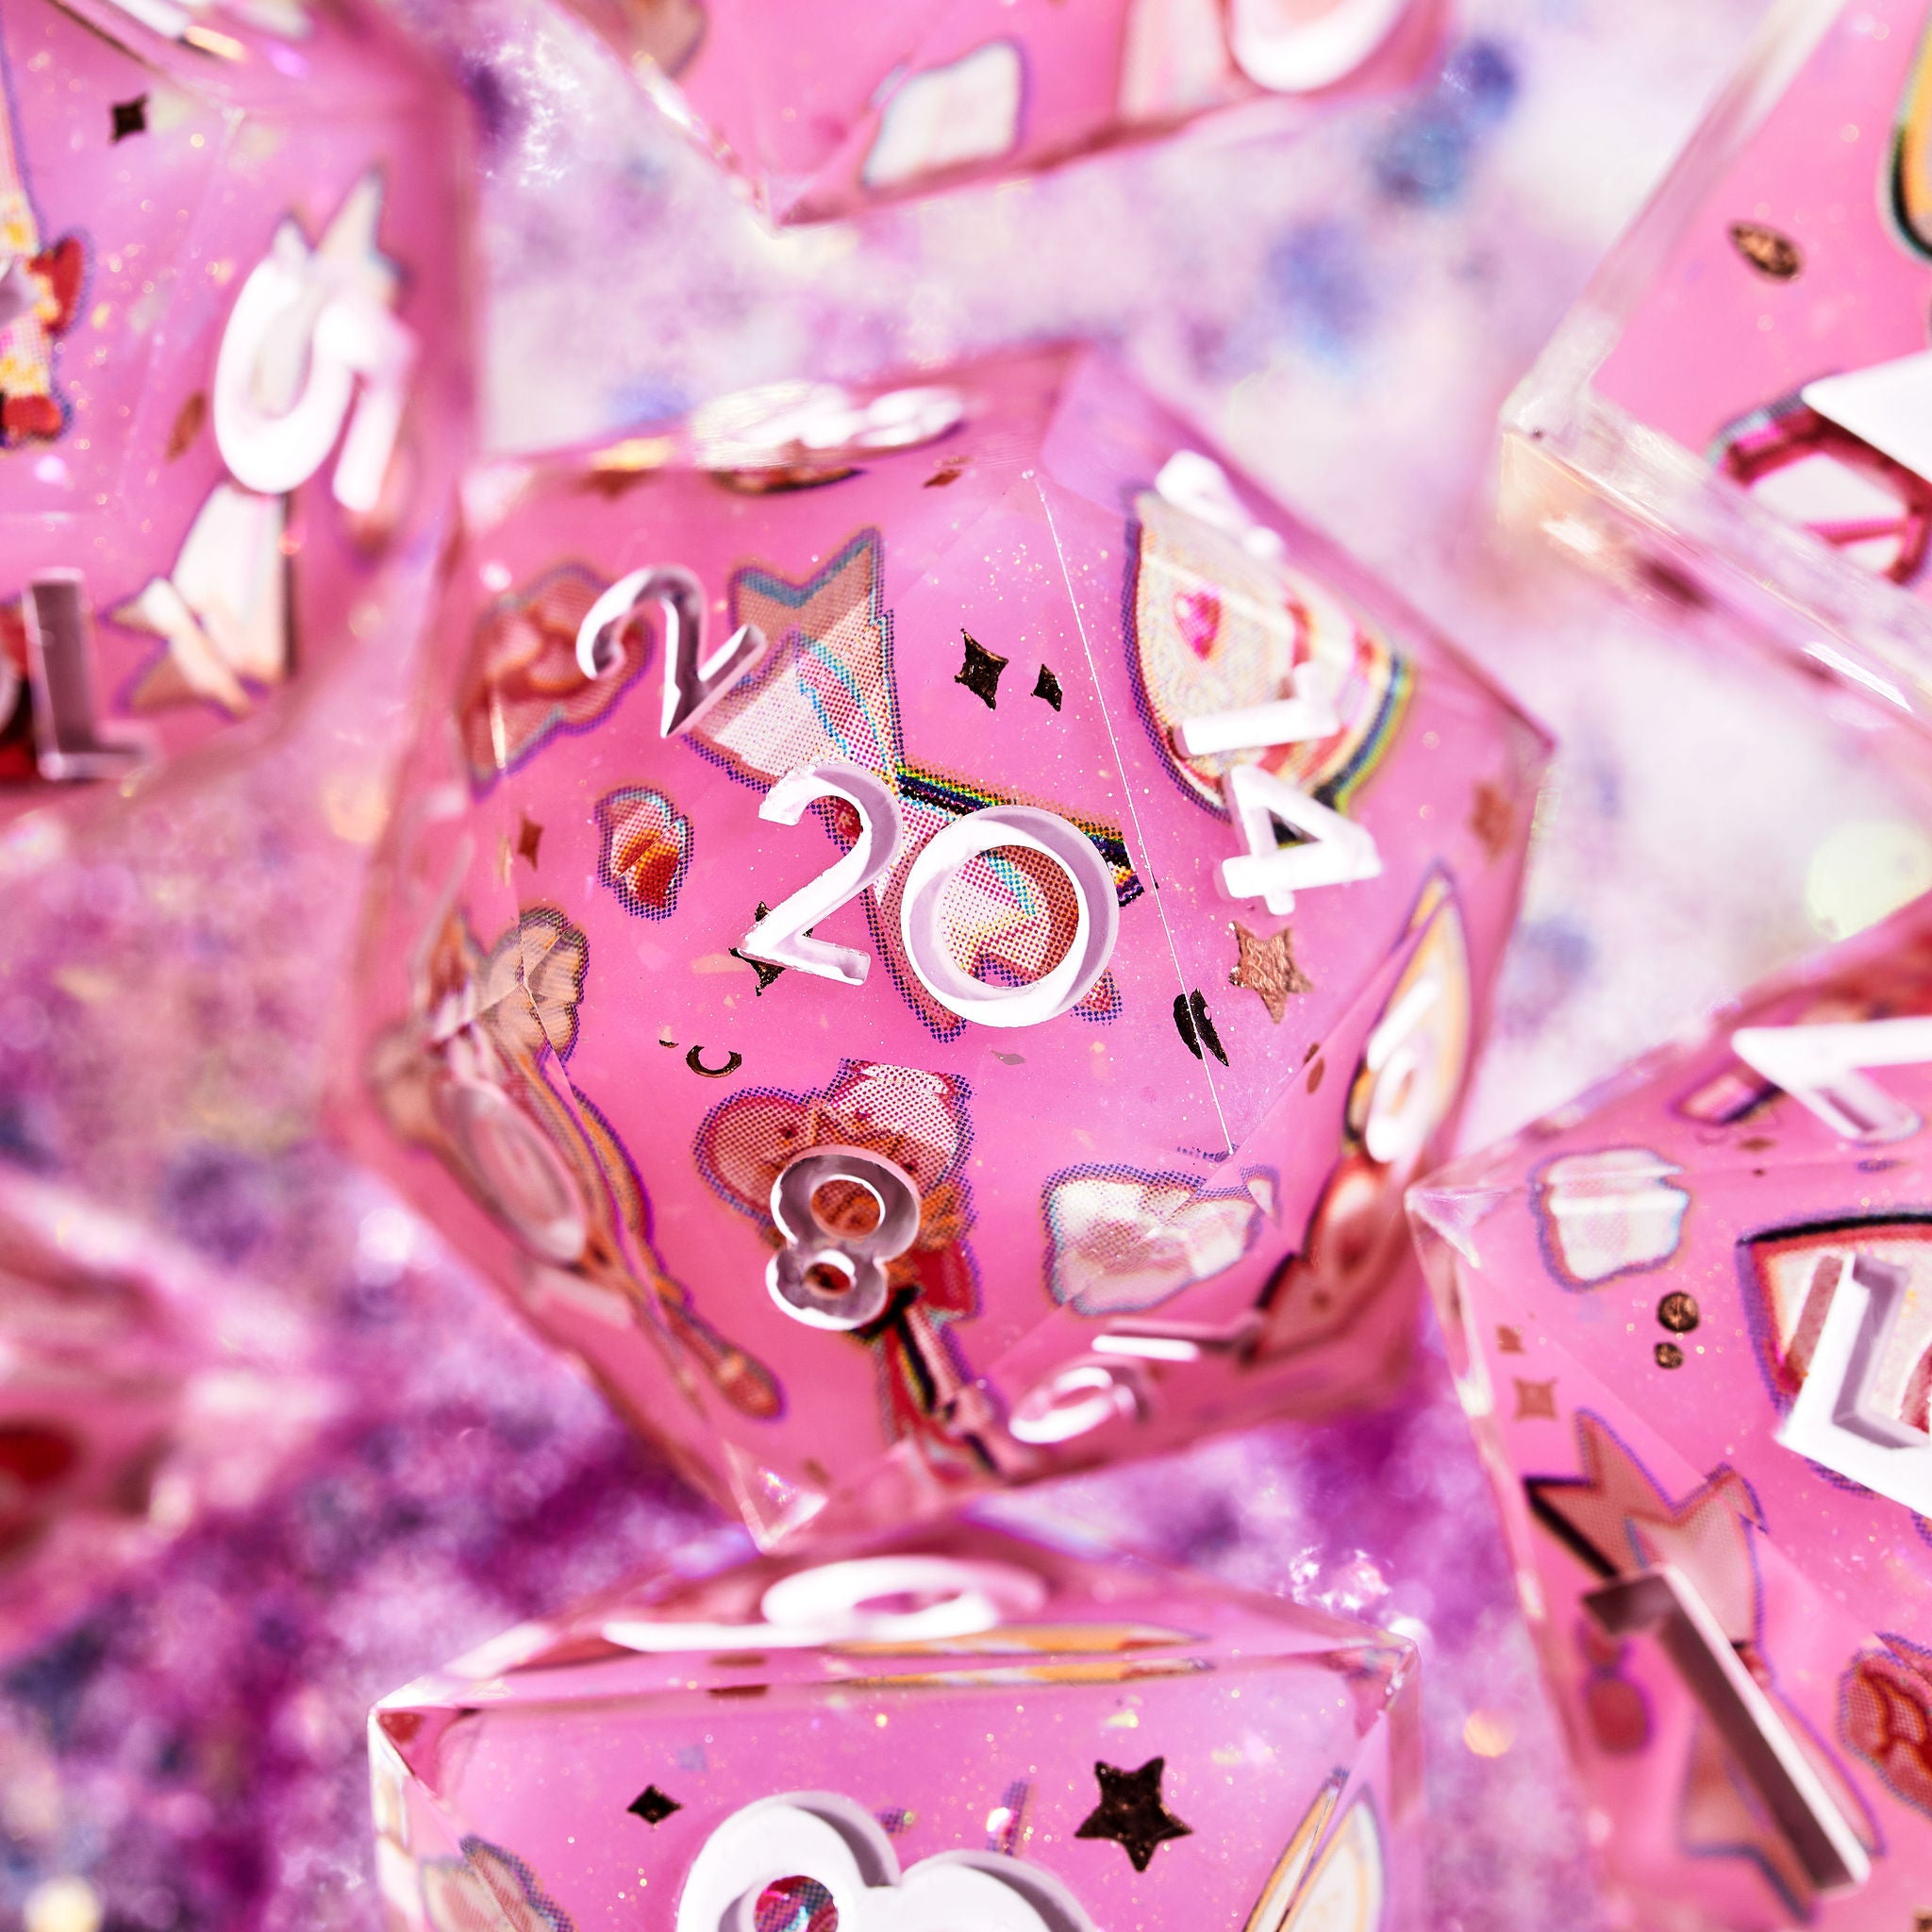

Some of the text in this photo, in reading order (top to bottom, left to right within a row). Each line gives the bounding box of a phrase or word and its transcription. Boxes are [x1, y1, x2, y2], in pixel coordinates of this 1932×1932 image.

[575, 564, 769, 739] 2
[738, 758, 1123, 1028] 20
[1173, 660, 1383, 916] 14
[765, 1143, 922, 1331] 8
